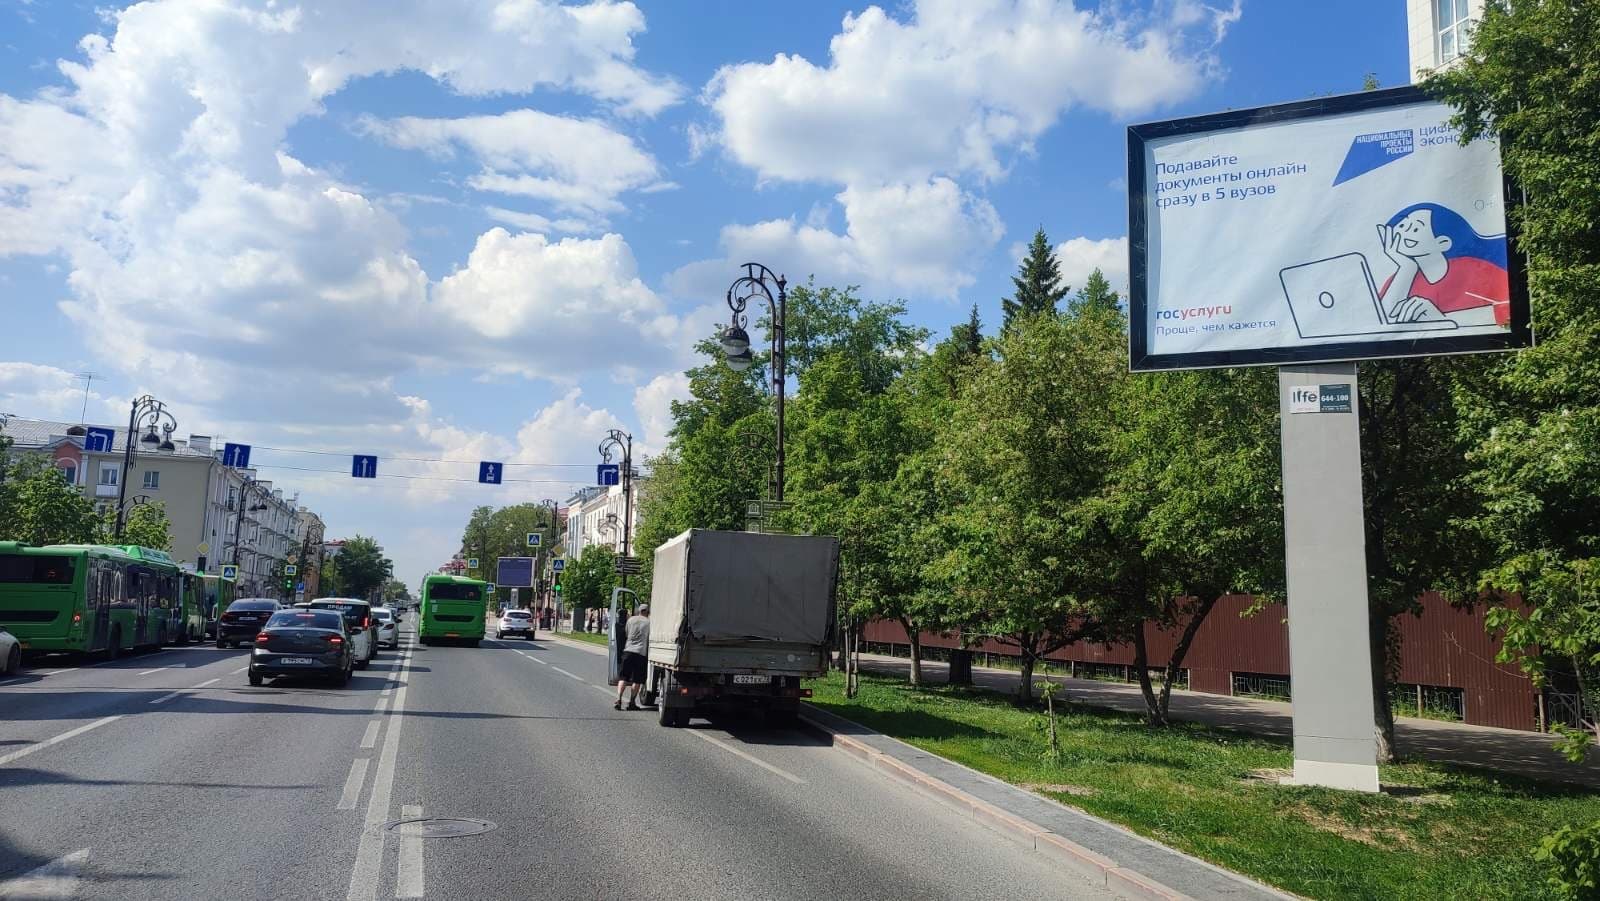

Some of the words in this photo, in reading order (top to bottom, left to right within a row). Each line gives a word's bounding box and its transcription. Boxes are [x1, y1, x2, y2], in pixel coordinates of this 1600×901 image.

[1356, 129, 1413, 144] НАЦИОНАЛЬНЫЕ
[1380, 138, 1413, 148] ПРОЕКТЫ
[1386, 145, 1413, 155] РОССИИ
[1155, 154, 1238, 176] Подавайте
[1155, 171, 1242, 194] документы
[1246, 163, 1307, 180] онлайн
[1155, 192, 1198, 210] сразу
[1202, 193, 1210, 202] в
[1216, 188, 1226, 200] 5
[1230, 184, 1276, 201] вузов
[1156, 325, 1199, 337] Проще,
[1202, 323, 1225, 332] чем
[1228, 319, 1276, 330] кажется
